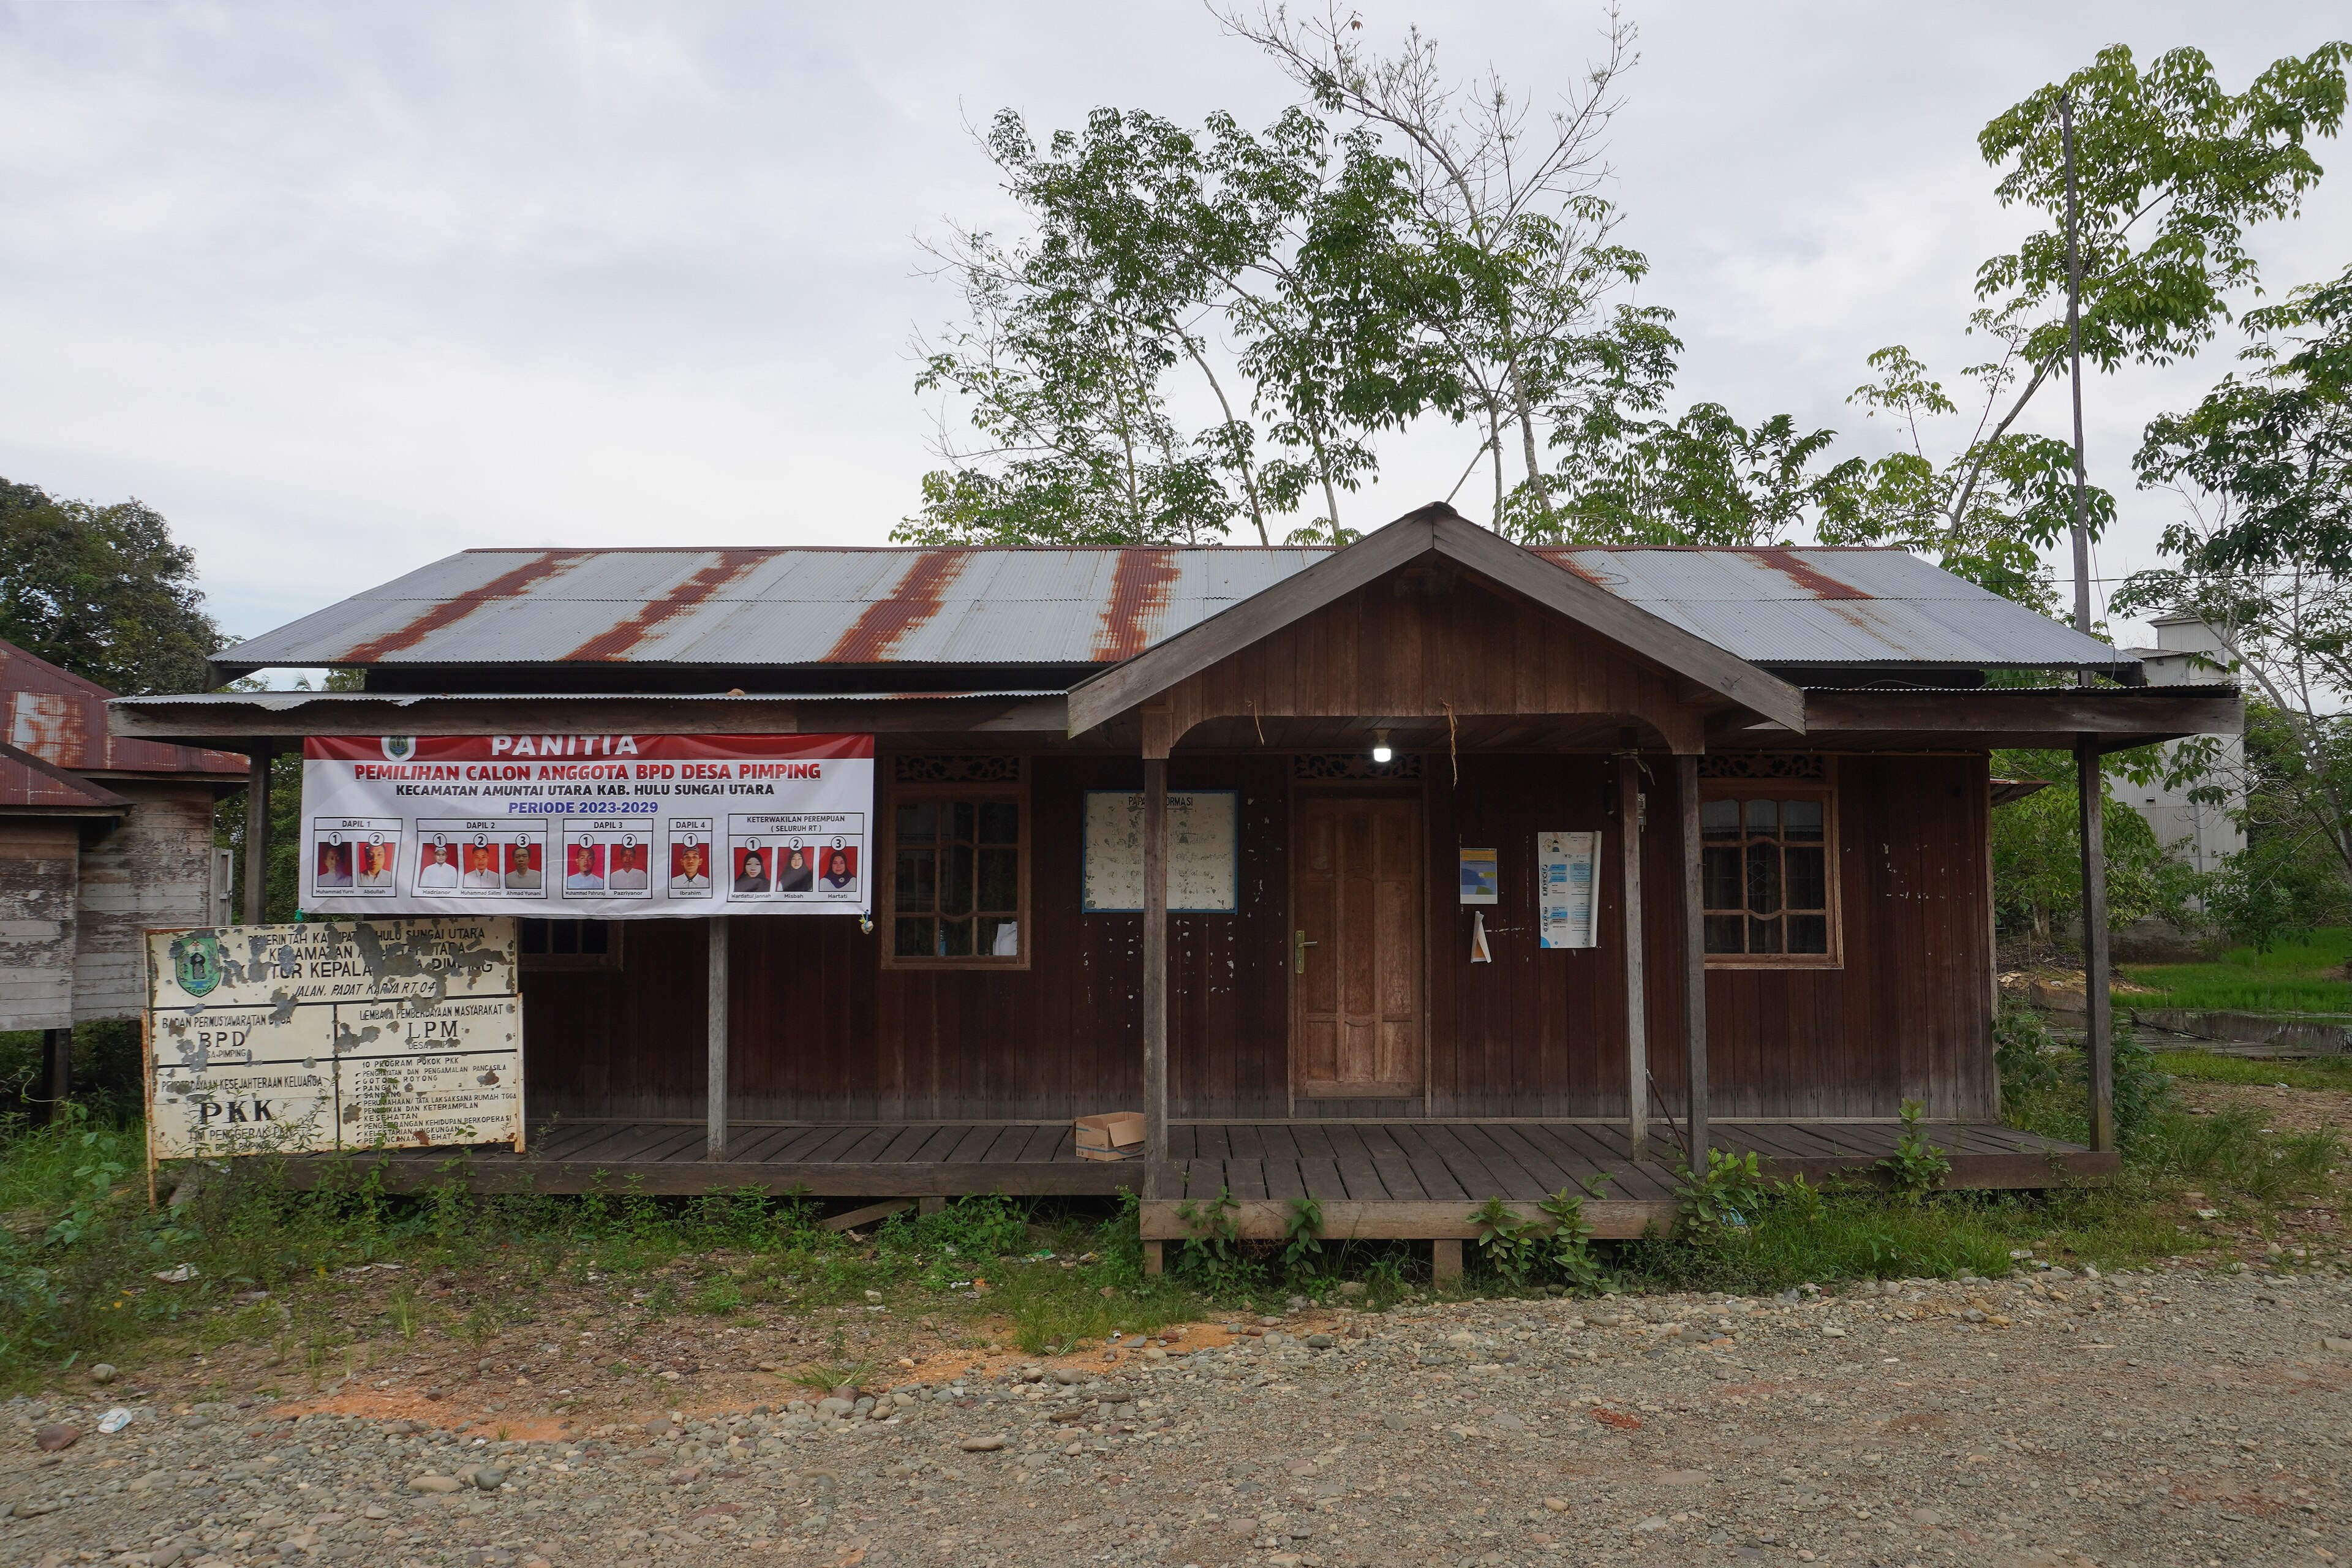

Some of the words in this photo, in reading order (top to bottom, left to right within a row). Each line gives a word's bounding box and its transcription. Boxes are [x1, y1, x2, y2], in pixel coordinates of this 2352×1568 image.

[492, 735, 638, 756] PANITIA
[355, 764, 459, 781] PEMILIHAN
[466, 765, 530, 781] CALON
[537, 764, 629, 781] ANGGOTA
[636, 764, 674, 780] BPD
[682, 764, 732, 779] DESA
[739, 764, 821, 779] PIMPING
[396, 785, 478, 796] KECAMATAN
[482, 785, 543, 796] AMUNTAI
[548, 785, 592, 796] UTARA
[597, 785, 630, 796] KAB.
[635, 785, 670, 796] HULU
[674, 784, 724, 796] SUNGAI
[729, 784, 775, 795] UTARA
[508, 802, 575, 813] PERIODE
[579, 801, 658, 813] 2023-2029
[333, 835, 337, 844] 1
[373, 835, 380, 844] 2
[437, 836, 442, 845] 1
[478, 837, 484, 845] 2
[520, 836, 526, 845] 3
[583, 837, 588, 846] 1
[626, 837, 633, 846] 2
[688, 835, 693, 845] 1
[750, 840, 755, 849] 1
[793, 839, 799, 848] 2
[835, 839, 842, 848] 3
[247, 933, 307, 946] PERINTAH
[448, 927, 485, 940] UTARA
[311, 960, 373, 979] KEPALA
[331, 984, 364, 996] PADAT
[455, 1004, 503, 1017] MASYARAKAT
[162, 1017, 192, 1029] BADAN
[194, 1014, 266, 1028] PERMUSYAWARATAN
[407, 1020, 458, 1040] LPM
[199, 1031, 246, 1048] BPD
[374, 1059, 413, 1068] PROGRAM
[424, 1066, 468, 1074] PENGAMALAN
[219, 1077, 283, 1090] KESEJAHTERAAN
[284, 1075, 323, 1088] KELUARGA
[423, 1102, 478, 1111] KETERAMPILAN
[200, 1099, 274, 1125] PKK
[364, 1112, 418, 1122] KESEHATAN
[425, 1117, 462, 1126] KEHIDUPAN
[464, 1115, 512, 1124] BERKOPERASI
[209, 1128, 268, 1141] PENGERAK
